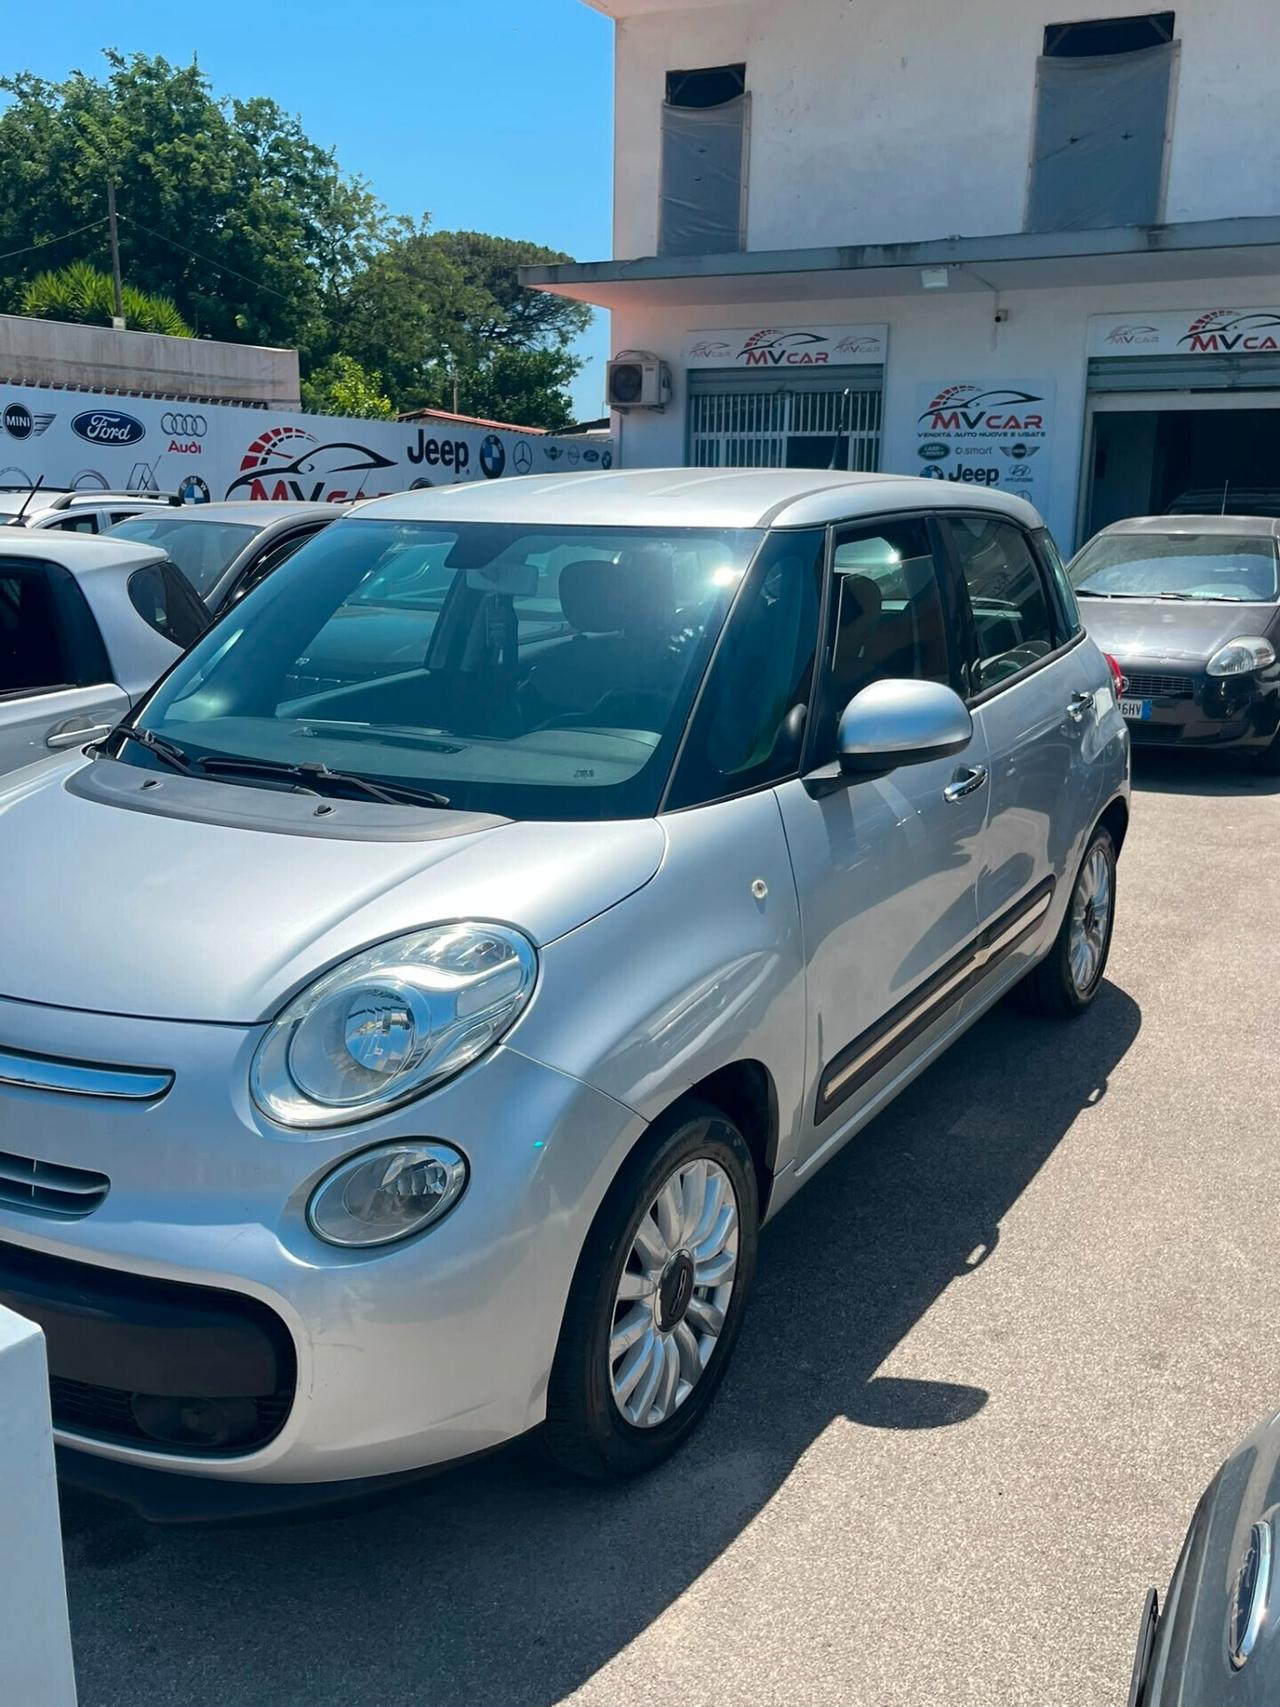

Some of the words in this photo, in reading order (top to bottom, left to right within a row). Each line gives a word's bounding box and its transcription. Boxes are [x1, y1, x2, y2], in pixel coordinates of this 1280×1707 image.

[6, 415, 31, 427] MINI
[86, 414, 131, 441] Ford
[168, 440, 202, 454] Audi
[406, 429, 469, 474] Jeep
[965, 447, 992, 455] smart
[948, 464, 999, 486] Jeep
